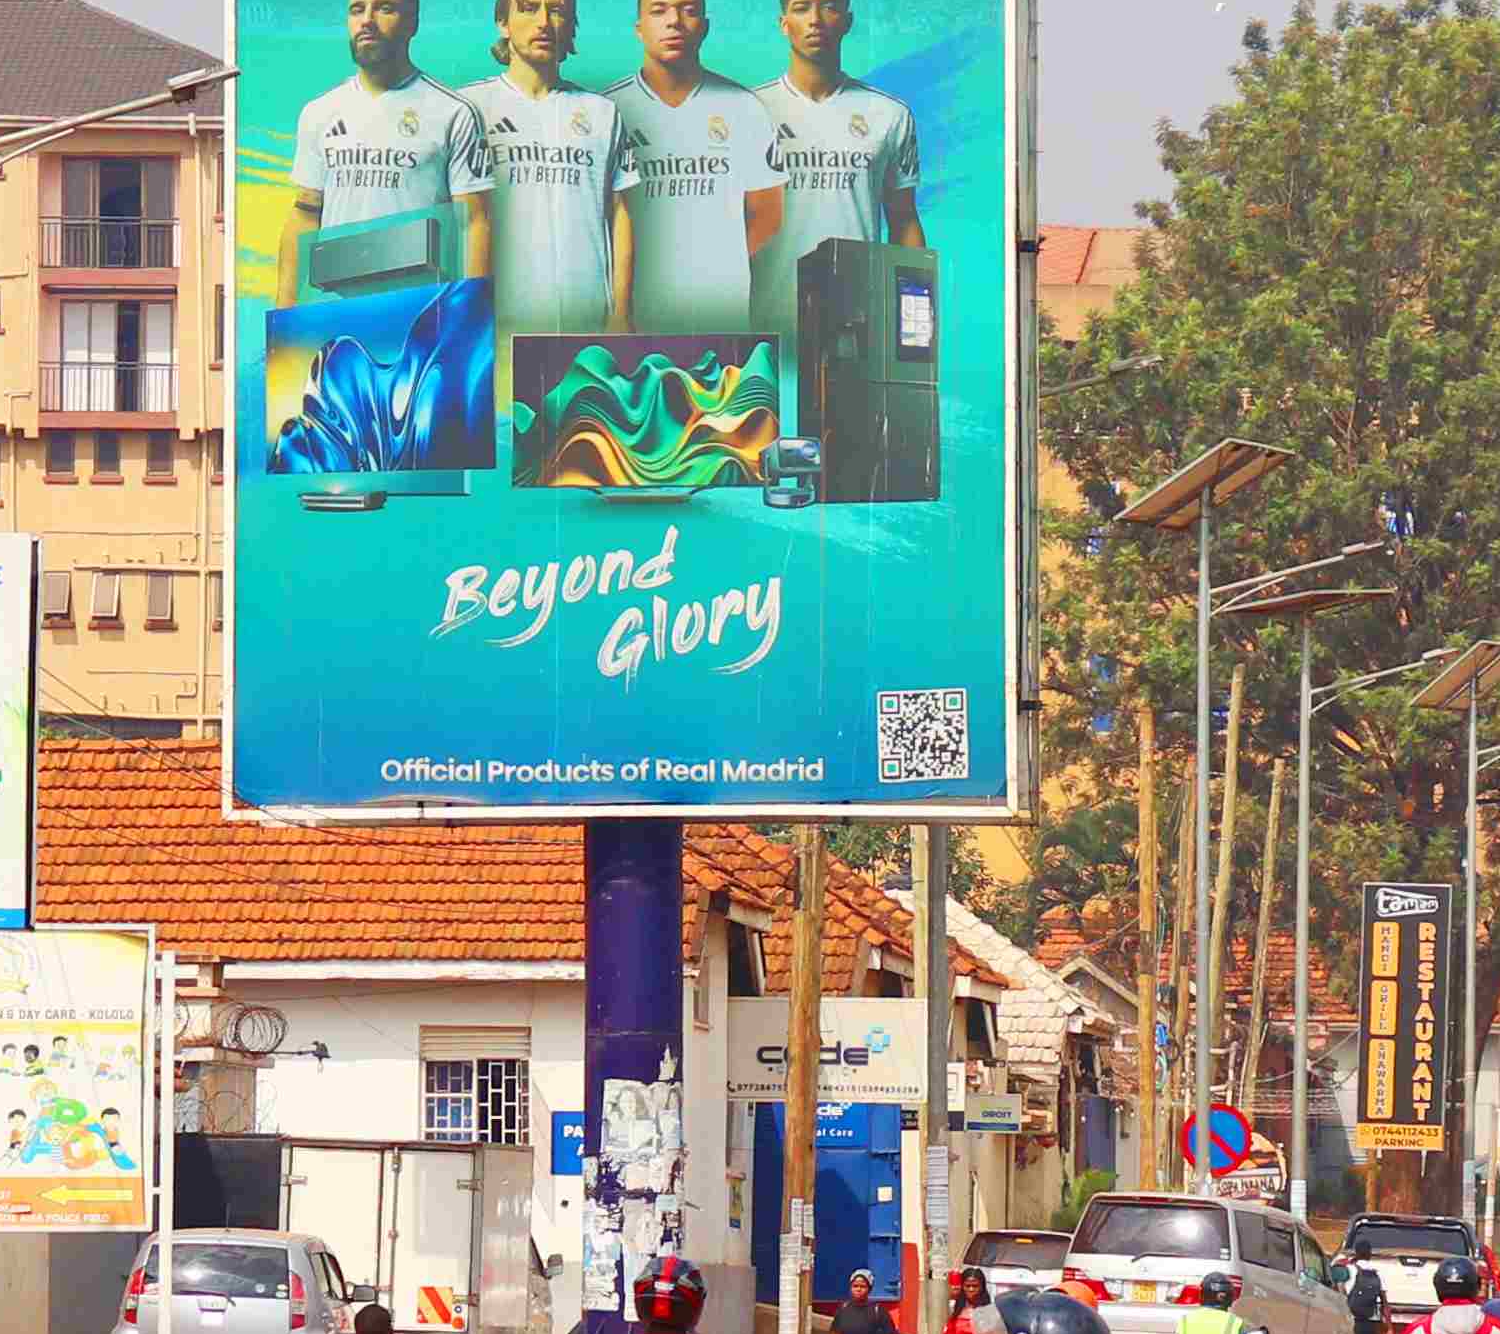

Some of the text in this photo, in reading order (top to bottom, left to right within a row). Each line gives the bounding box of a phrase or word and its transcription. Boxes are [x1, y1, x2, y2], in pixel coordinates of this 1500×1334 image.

[324, 143, 418, 170] Emirates
[492, 141, 595, 168] Emirates
[784, 147, 872, 170] mirates
[335, 168, 400, 189] FLY BETTER
[509, 165, 581, 186] FLY BETTER
[810, 171, 857, 190] BETTER
[644, 177, 716, 199] FLY BETTER
[430, 524, 680, 649] Beyond
[596, 576, 782, 694] Glory
[381, 756, 825, 785] Official Products of Real Madrid
[88, 1009, 135, 1020] KOLOLO
[1412, 922, 1437, 1121] RESTAURANT
[756, 1040, 869, 1066] cde
[563, 1125, 585, 1138] PA
[829, 1127, 854, 1138] Care
